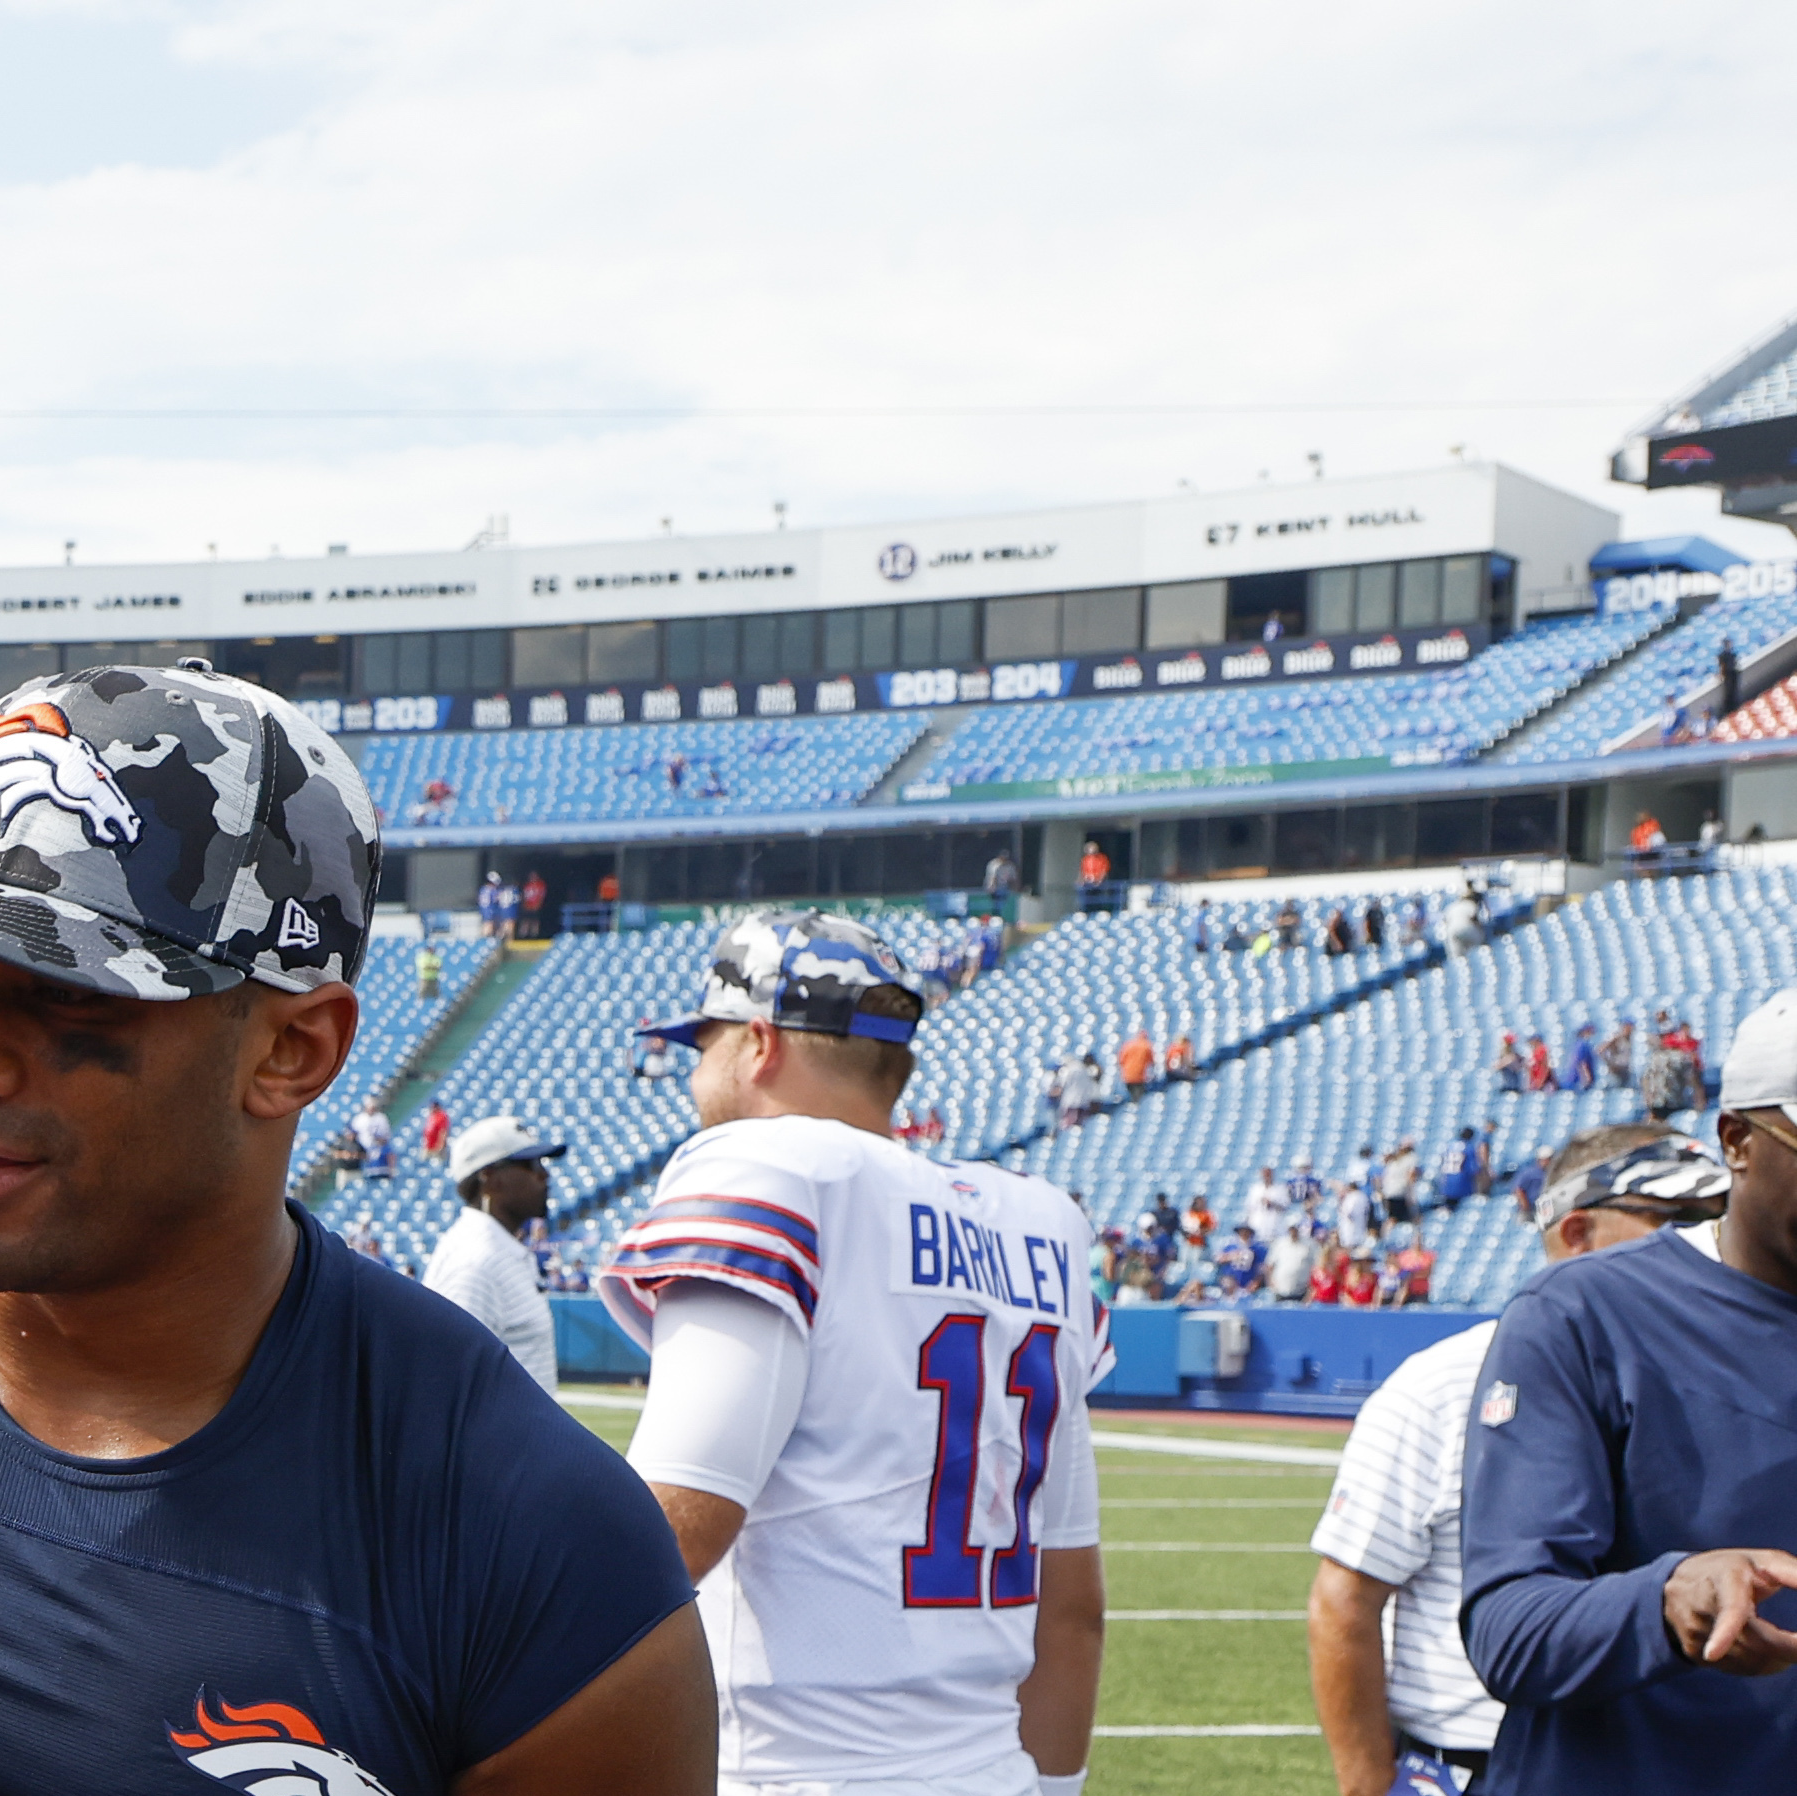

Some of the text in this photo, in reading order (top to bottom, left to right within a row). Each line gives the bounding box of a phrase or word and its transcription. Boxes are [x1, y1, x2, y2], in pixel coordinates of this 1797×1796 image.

[1256, 515, 1332, 538] KENT
[1347, 507, 1426, 531] HULL
[928, 548, 973, 568] JIM
[982, 543, 1059, 564] KELLY
[575, 570, 682, 591] GEORGE
[93, 595, 183, 611] JAMES
[889, 667, 958, 708] 203
[992, 660, 1061, 700] 204
[374, 696, 438, 731] 203
[910, 1203, 1069, 1319] BARKLEY
[902, 1314, 1060, 1609] 11
